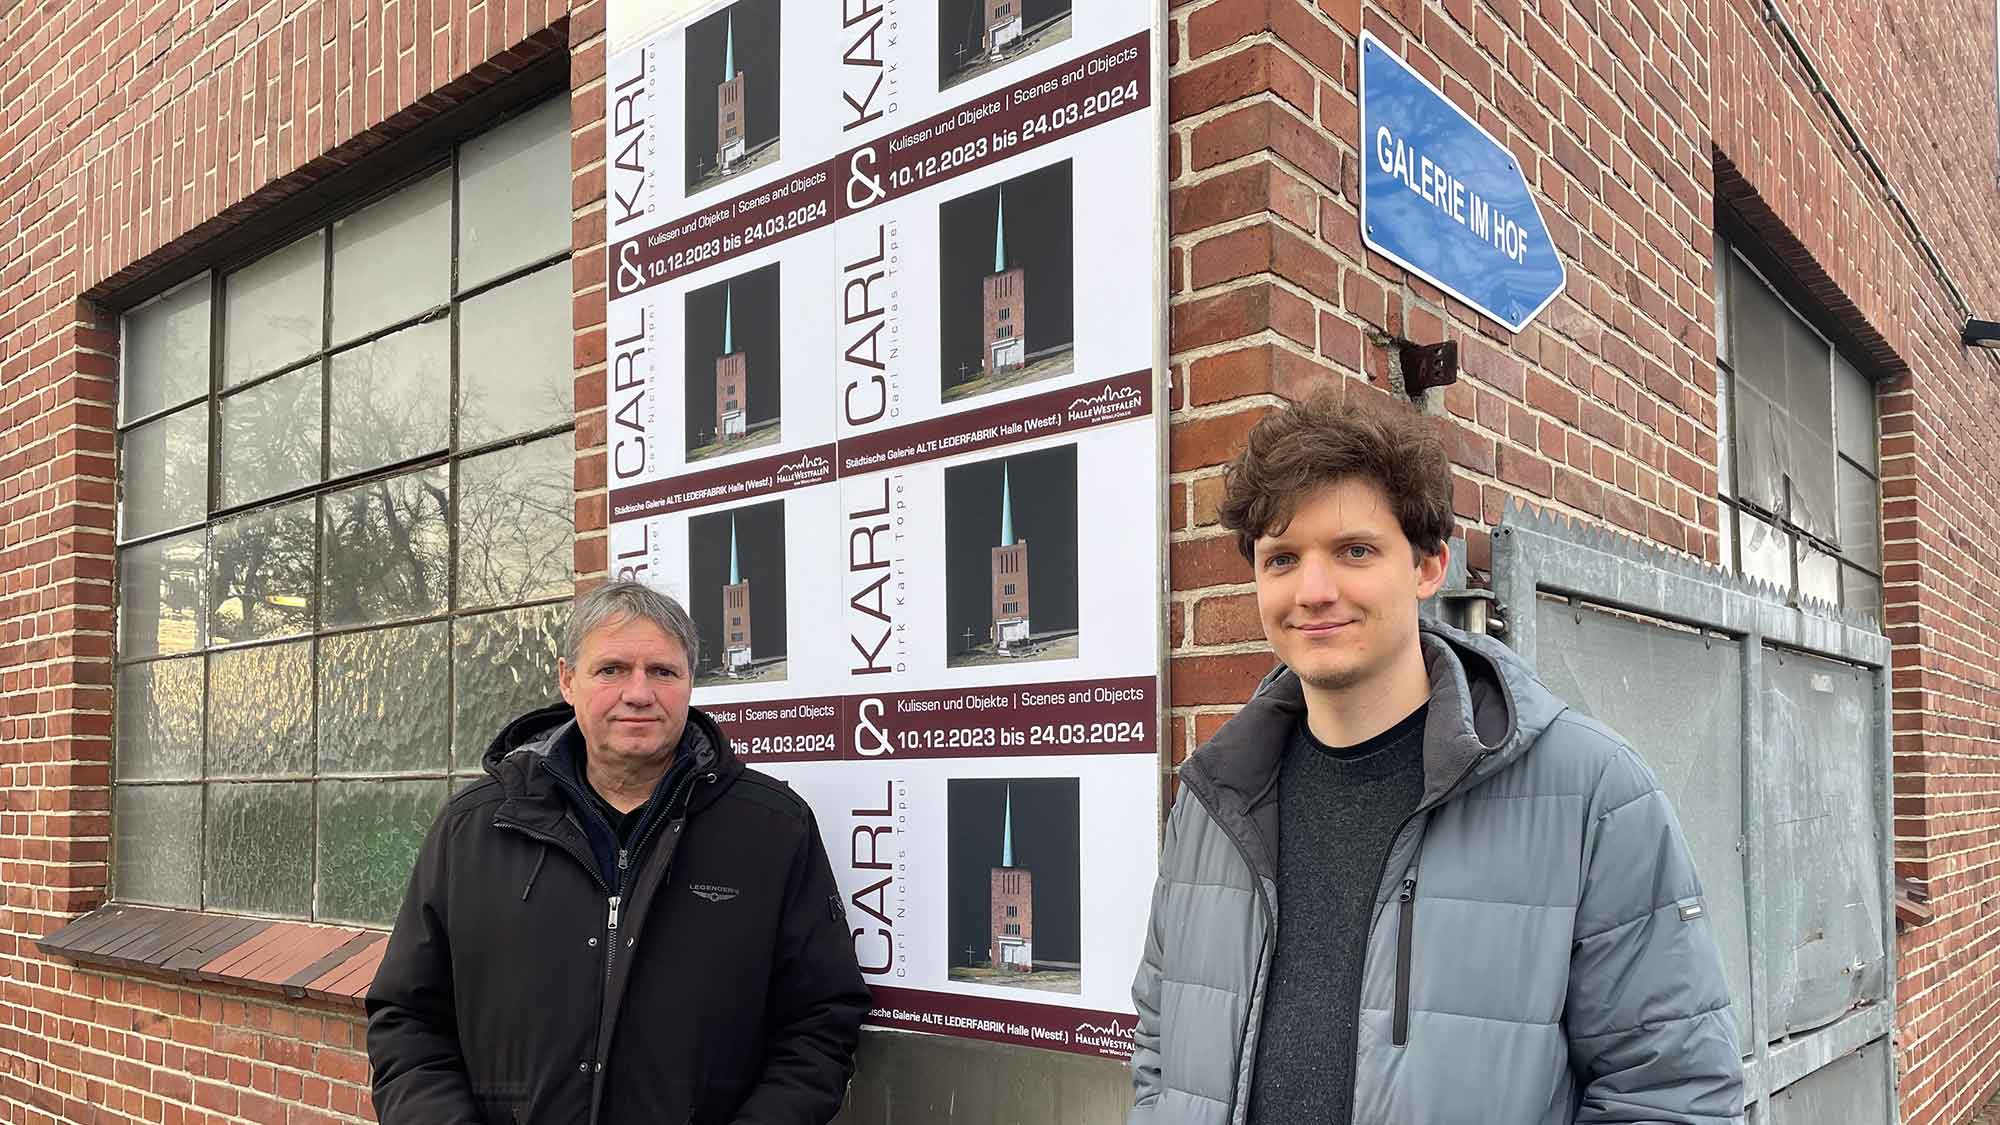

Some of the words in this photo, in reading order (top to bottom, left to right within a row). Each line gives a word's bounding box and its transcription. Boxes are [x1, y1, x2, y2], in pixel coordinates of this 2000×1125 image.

[888, 63, 898, 113] Dirk
[889, 128, 933, 153] Kulissen
[935, 113, 955, 136] und
[957, 100, 1001, 127] Objekte
[1013, 78, 1059, 105] Scenes
[1061, 65, 1085, 86] and
[1087, 47, 1138, 76] Objects
[615, 48, 645, 227] KARL
[889, 142, 988, 190] 10.12.2023
[992, 128, 1018, 152] bis
[1022, 79, 1139, 141] 24.03.2024
[846, 147, 886, 210] &
[1377, 126, 1465, 224] GALERIE
[1470, 191, 1489, 242] IM
[1494, 207, 1528, 265] HOF
[647, 238, 720, 278] 10.12.2023
[723, 232, 742, 251] bis
[744, 199, 827, 243] 24.03.2024
[648, 228, 680, 248] Kulissen
[682, 220, 697, 236] und
[698, 208, 730, 230] Objekte
[738, 194, 770, 214] Scenes
[772, 183, 789, 200] and
[791, 171, 826, 193] Objects
[616, 240, 647, 293] &
[889, 220, 899, 277] Topel
[844, 224, 886, 426] CARL
[889, 290, 899, 359] Niclas
[615, 307, 645, 480] CARL
[890, 373, 899, 417] Carl
[846, 451, 886, 470] Städtische
[887, 444, 915, 461] Galerie
[916, 437, 937, 455] ALTE
[938, 427, 998, 450] LEDERFABRIK
[1000, 421, 1022, 438] Halle
[1024, 413, 1062, 436] (Westf.)
[666, 494, 682, 506] ALTE
[683, 486, 727, 503] LEDERFABRIK
[728, 483, 744, 494] Halle
[894, 474, 906, 541] Topel
[849, 478, 892, 675] KARL
[896, 558, 905, 606] Karl
[896, 624, 906, 673] Dirk
[745, 708, 778, 721] Scenes
[780, 706, 797, 719] and
[798, 704, 835, 720] Objects
[854, 698, 894, 756] &
[898, 698, 941, 713] Kulissen
[943, 696, 963, 711] und
[965, 694, 1009, 712] Objekte
[1021, 690, 1066, 708] Scenes
[1068, 688, 1091, 704] and
[1094, 687, 1144, 707] Objects
[751, 734, 836, 755] 24.03.2024
[898, 727, 996, 750] 10.12.2023
[1000, 727, 1025, 746] bis
[1030, 721, 1145, 746] 24.03.2024
[852, 780, 893, 975] CARL
[892, 1009, 921, 1023] Galerie
[922, 1013, 943, 1025] ALTE
[944, 1016, 1005, 1034] LEDERFABRIK
[1007, 1023, 1029, 1038] Halle
[1031, 1026, 1069, 1045] (Westf.)
